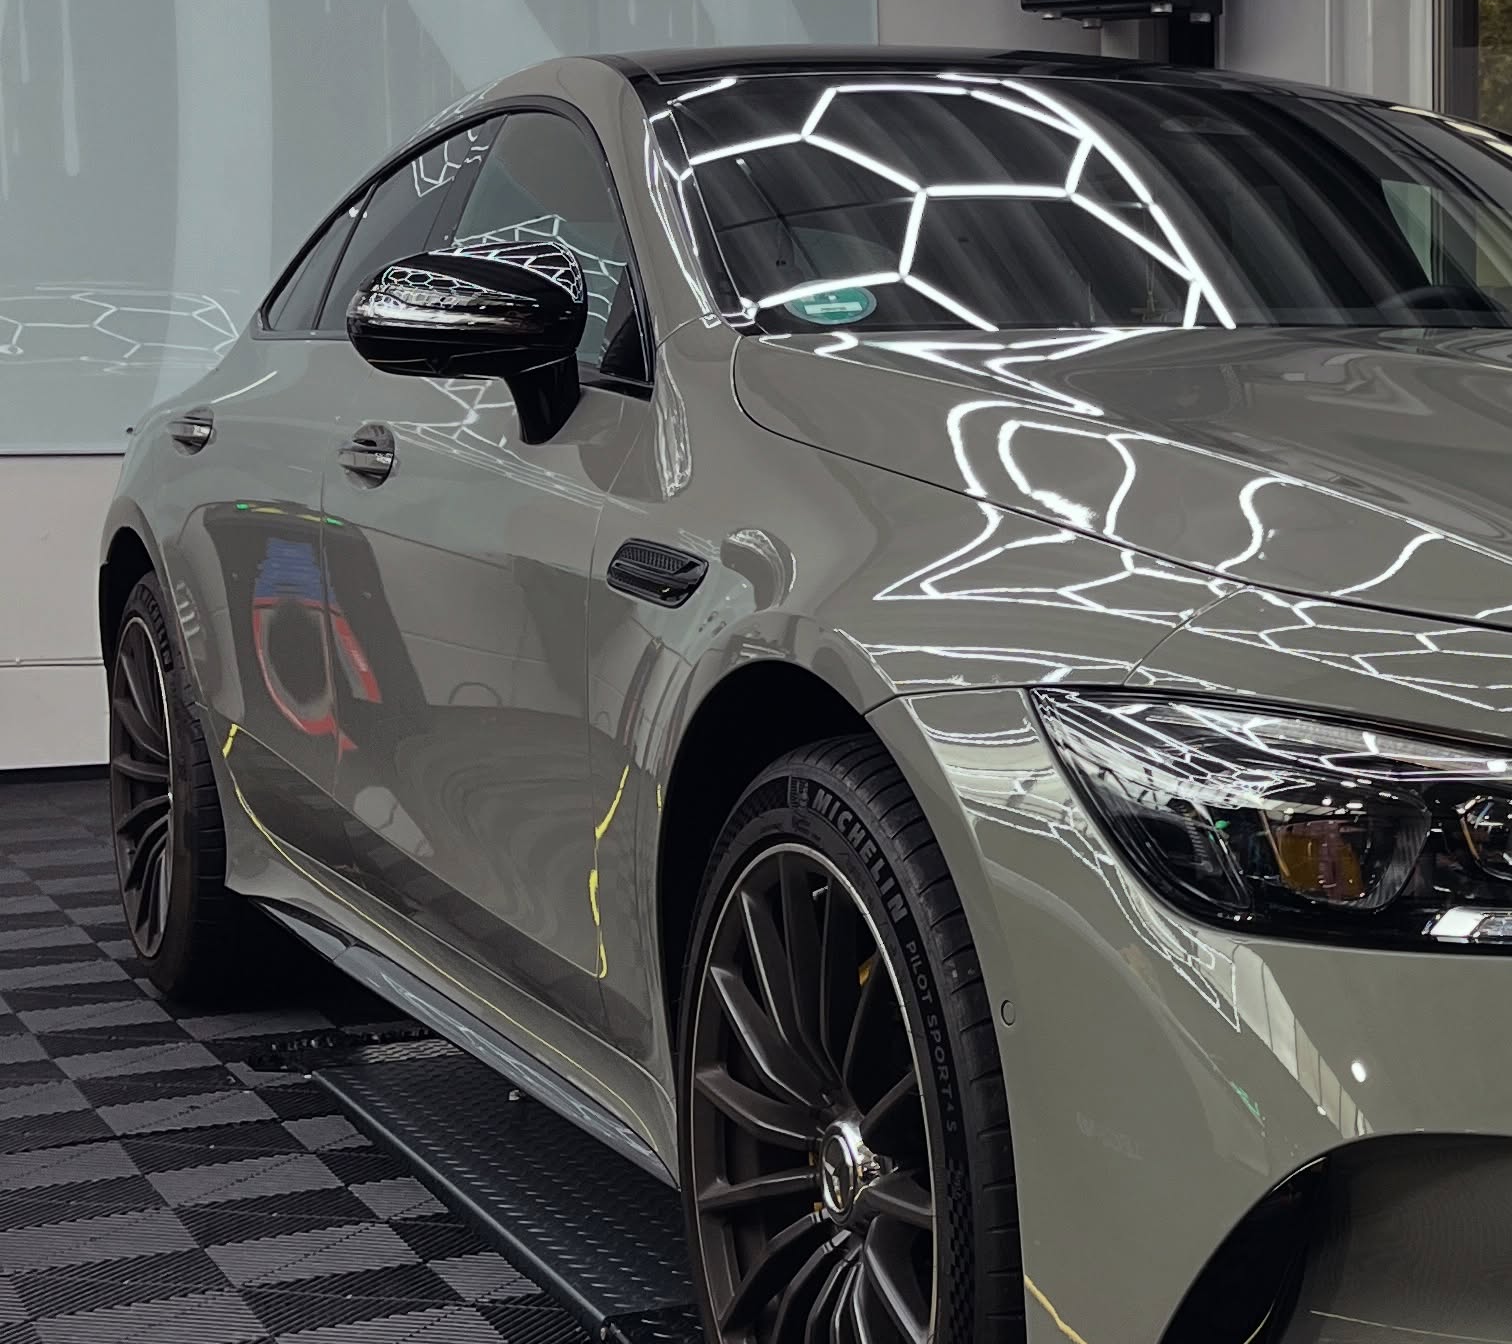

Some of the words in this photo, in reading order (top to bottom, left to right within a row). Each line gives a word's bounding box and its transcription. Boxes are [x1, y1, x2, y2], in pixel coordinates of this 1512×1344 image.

[812, 788, 909, 923] MICHELIN
[905, 940, 933, 1003] PILOT
[927, 1013, 953, 1098] SPORT
[946, 1120, 957, 1133] S
